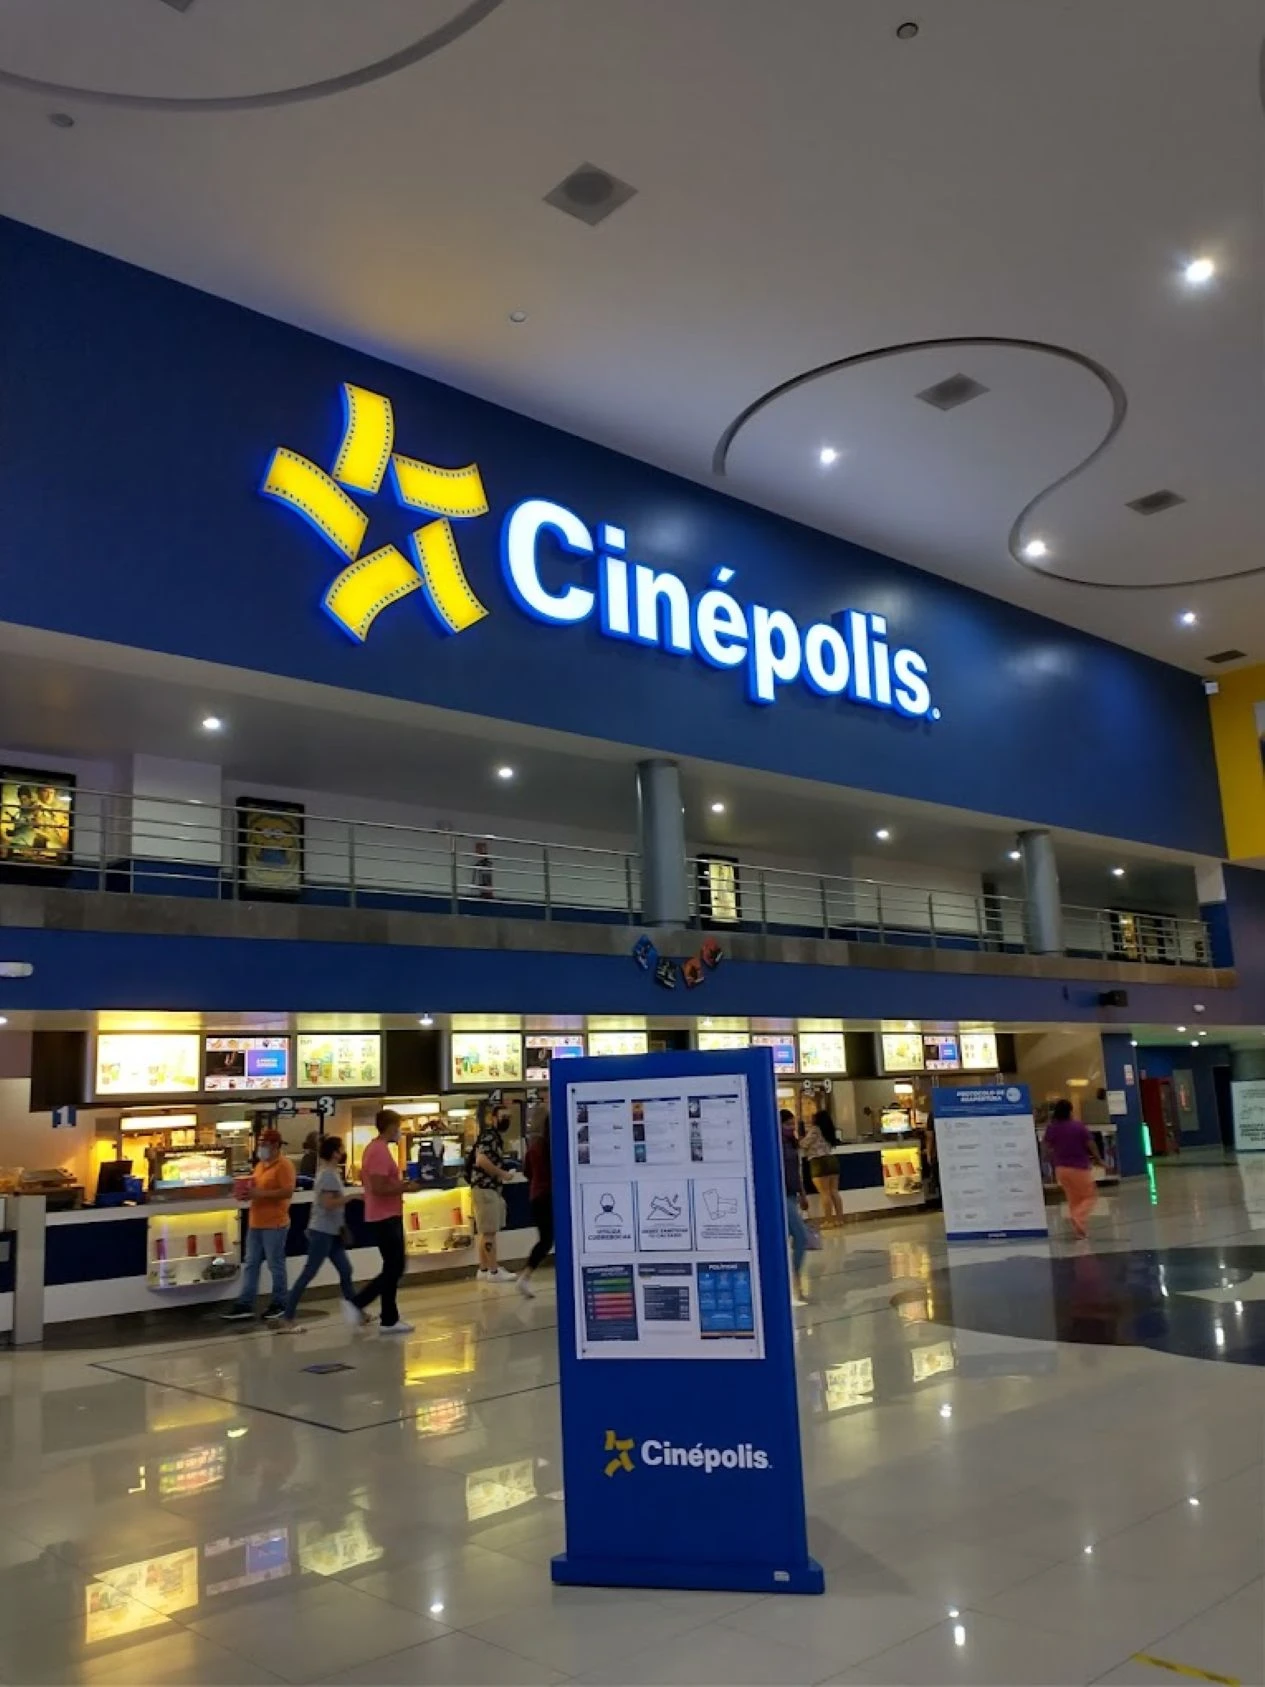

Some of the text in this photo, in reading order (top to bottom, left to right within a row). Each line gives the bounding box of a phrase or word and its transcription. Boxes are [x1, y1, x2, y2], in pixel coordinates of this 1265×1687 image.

[505, 499, 932, 715] Cinépolis
[56, 1105, 74, 1128] 1
[278, 1097, 296, 1118] 2
[319, 1095, 334, 1117] 3
[640, 1439, 770, 1473] Cinépolis
